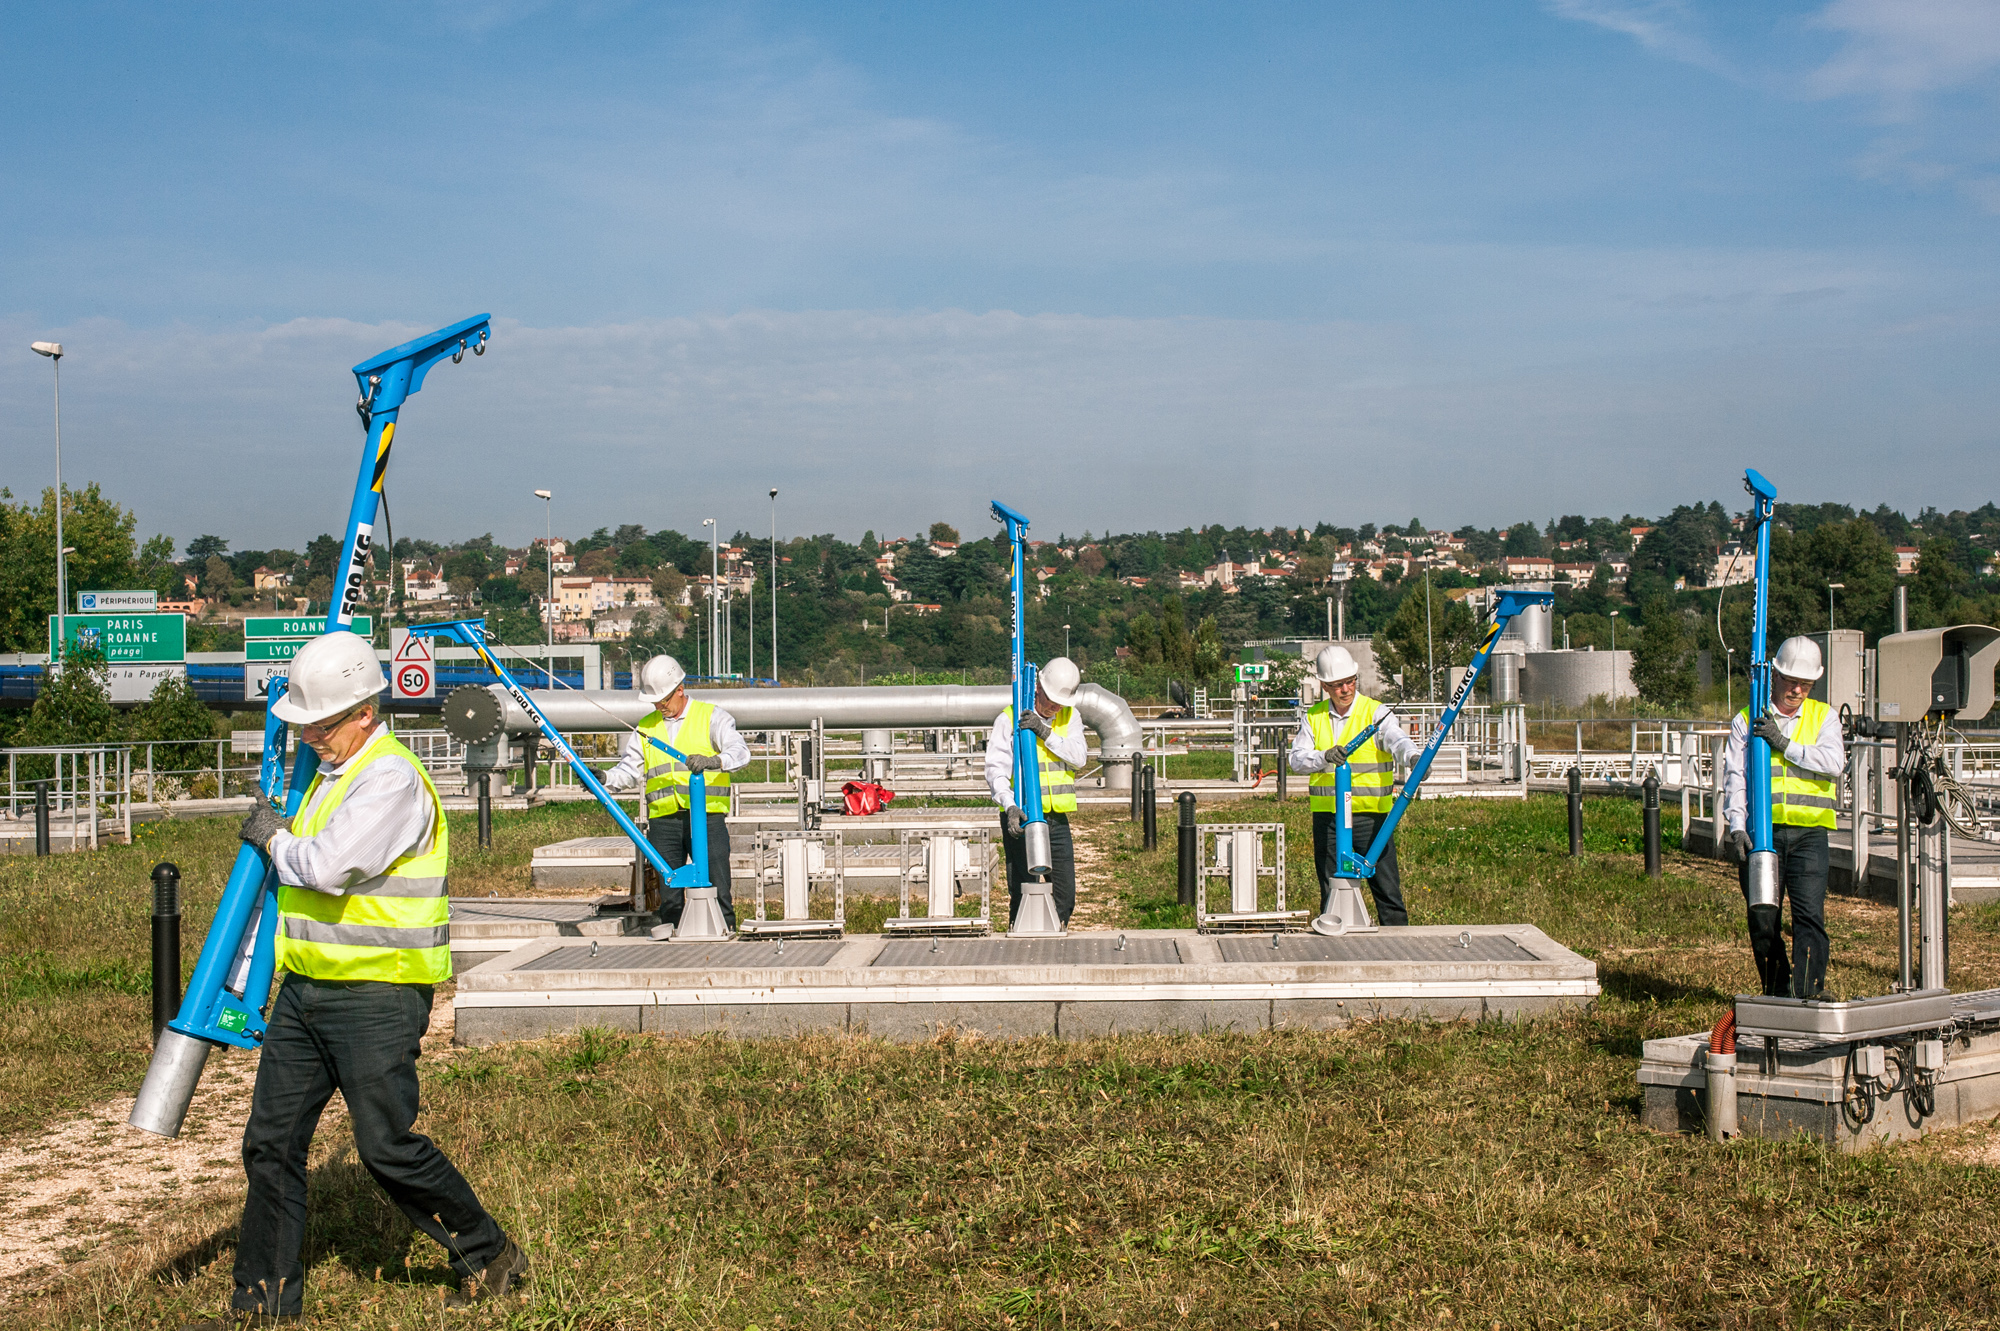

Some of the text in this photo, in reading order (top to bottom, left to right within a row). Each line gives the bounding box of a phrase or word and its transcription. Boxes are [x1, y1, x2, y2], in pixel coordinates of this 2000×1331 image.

[341, 533, 371, 616] 500 KG
[100, 596, 154, 605] PÉRIPHÉRIQUE
[107, 619, 144, 630] PARIS
[283, 621, 326, 633] ROANN
[107, 632, 158, 643] ROANNE
[110, 648, 141, 657] péage
[124, 670, 133, 678] la
[266, 668, 287, 676] Port
[403, 673, 424, 688] 50
[1450, 669, 1474, 707] 500 KG
[511, 689, 541, 724] 500 KG
